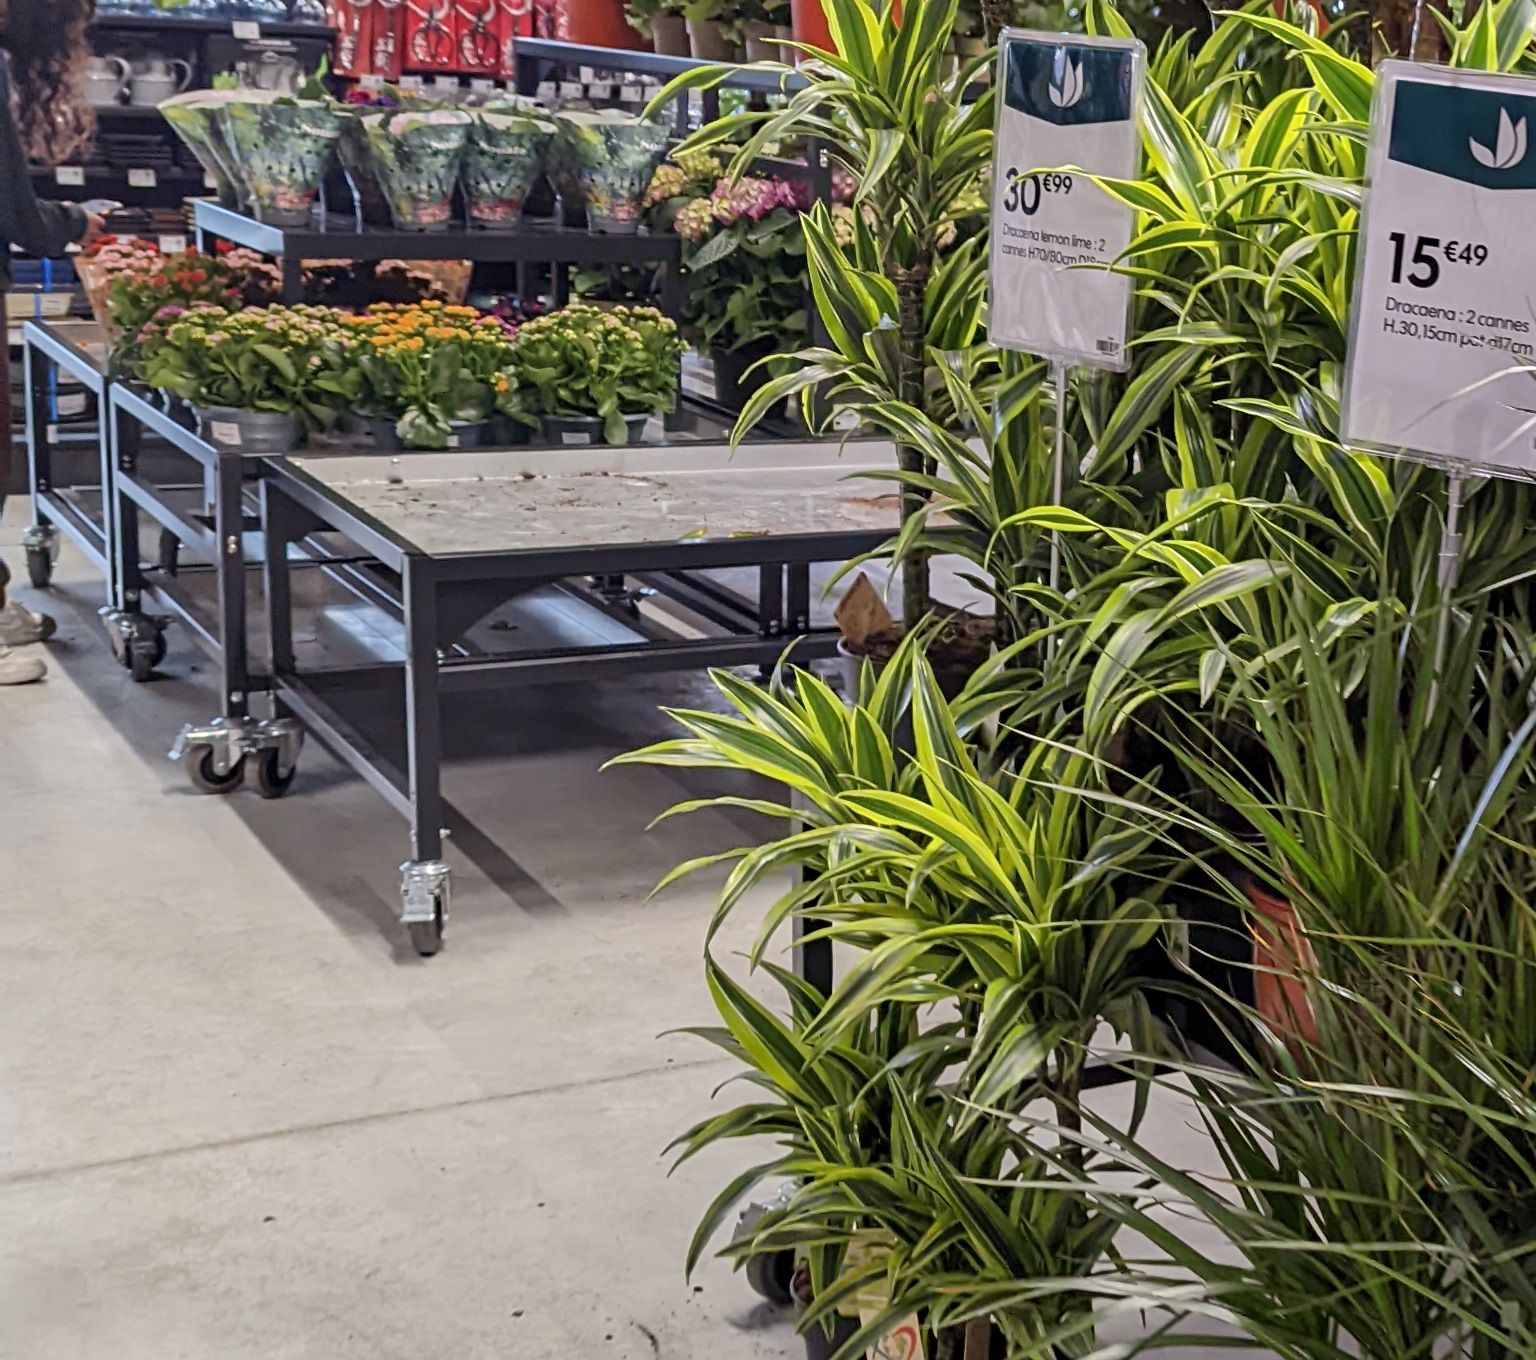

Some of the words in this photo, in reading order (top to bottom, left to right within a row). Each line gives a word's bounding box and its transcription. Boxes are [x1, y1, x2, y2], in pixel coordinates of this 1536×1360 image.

[1040, 230, 1070, 246] lemon
[1071, 234, 1092, 250] lime
[1098, 239, 1106, 252] 2
[1385, 296, 1456, 322] Dracaena
[1466, 309, 1476, 325] 2
[1477, 314, 1530, 333] cannes
[1459, 334, 1485, 348] pot
